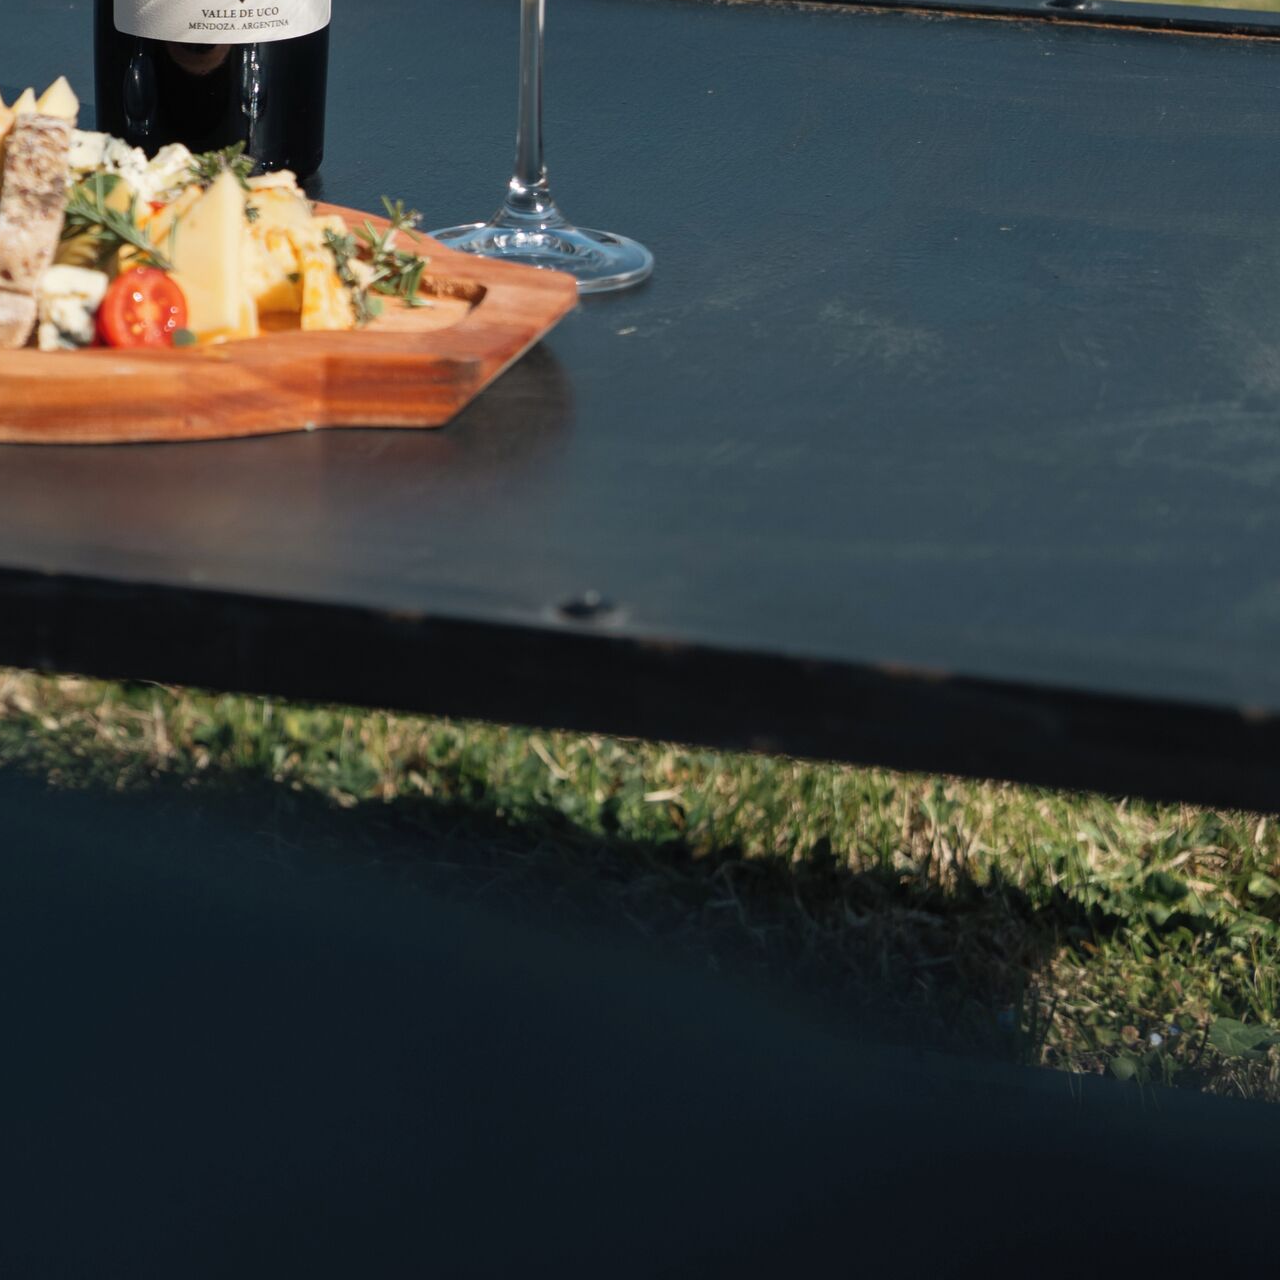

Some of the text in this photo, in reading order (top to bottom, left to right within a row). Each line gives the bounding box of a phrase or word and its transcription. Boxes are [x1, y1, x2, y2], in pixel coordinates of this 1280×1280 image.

[201, 6, 279, 18] VALLE DE UCO
[188, 22, 235, 31] MENDOZA
[241, 19, 289, 30] ARGENTINA
